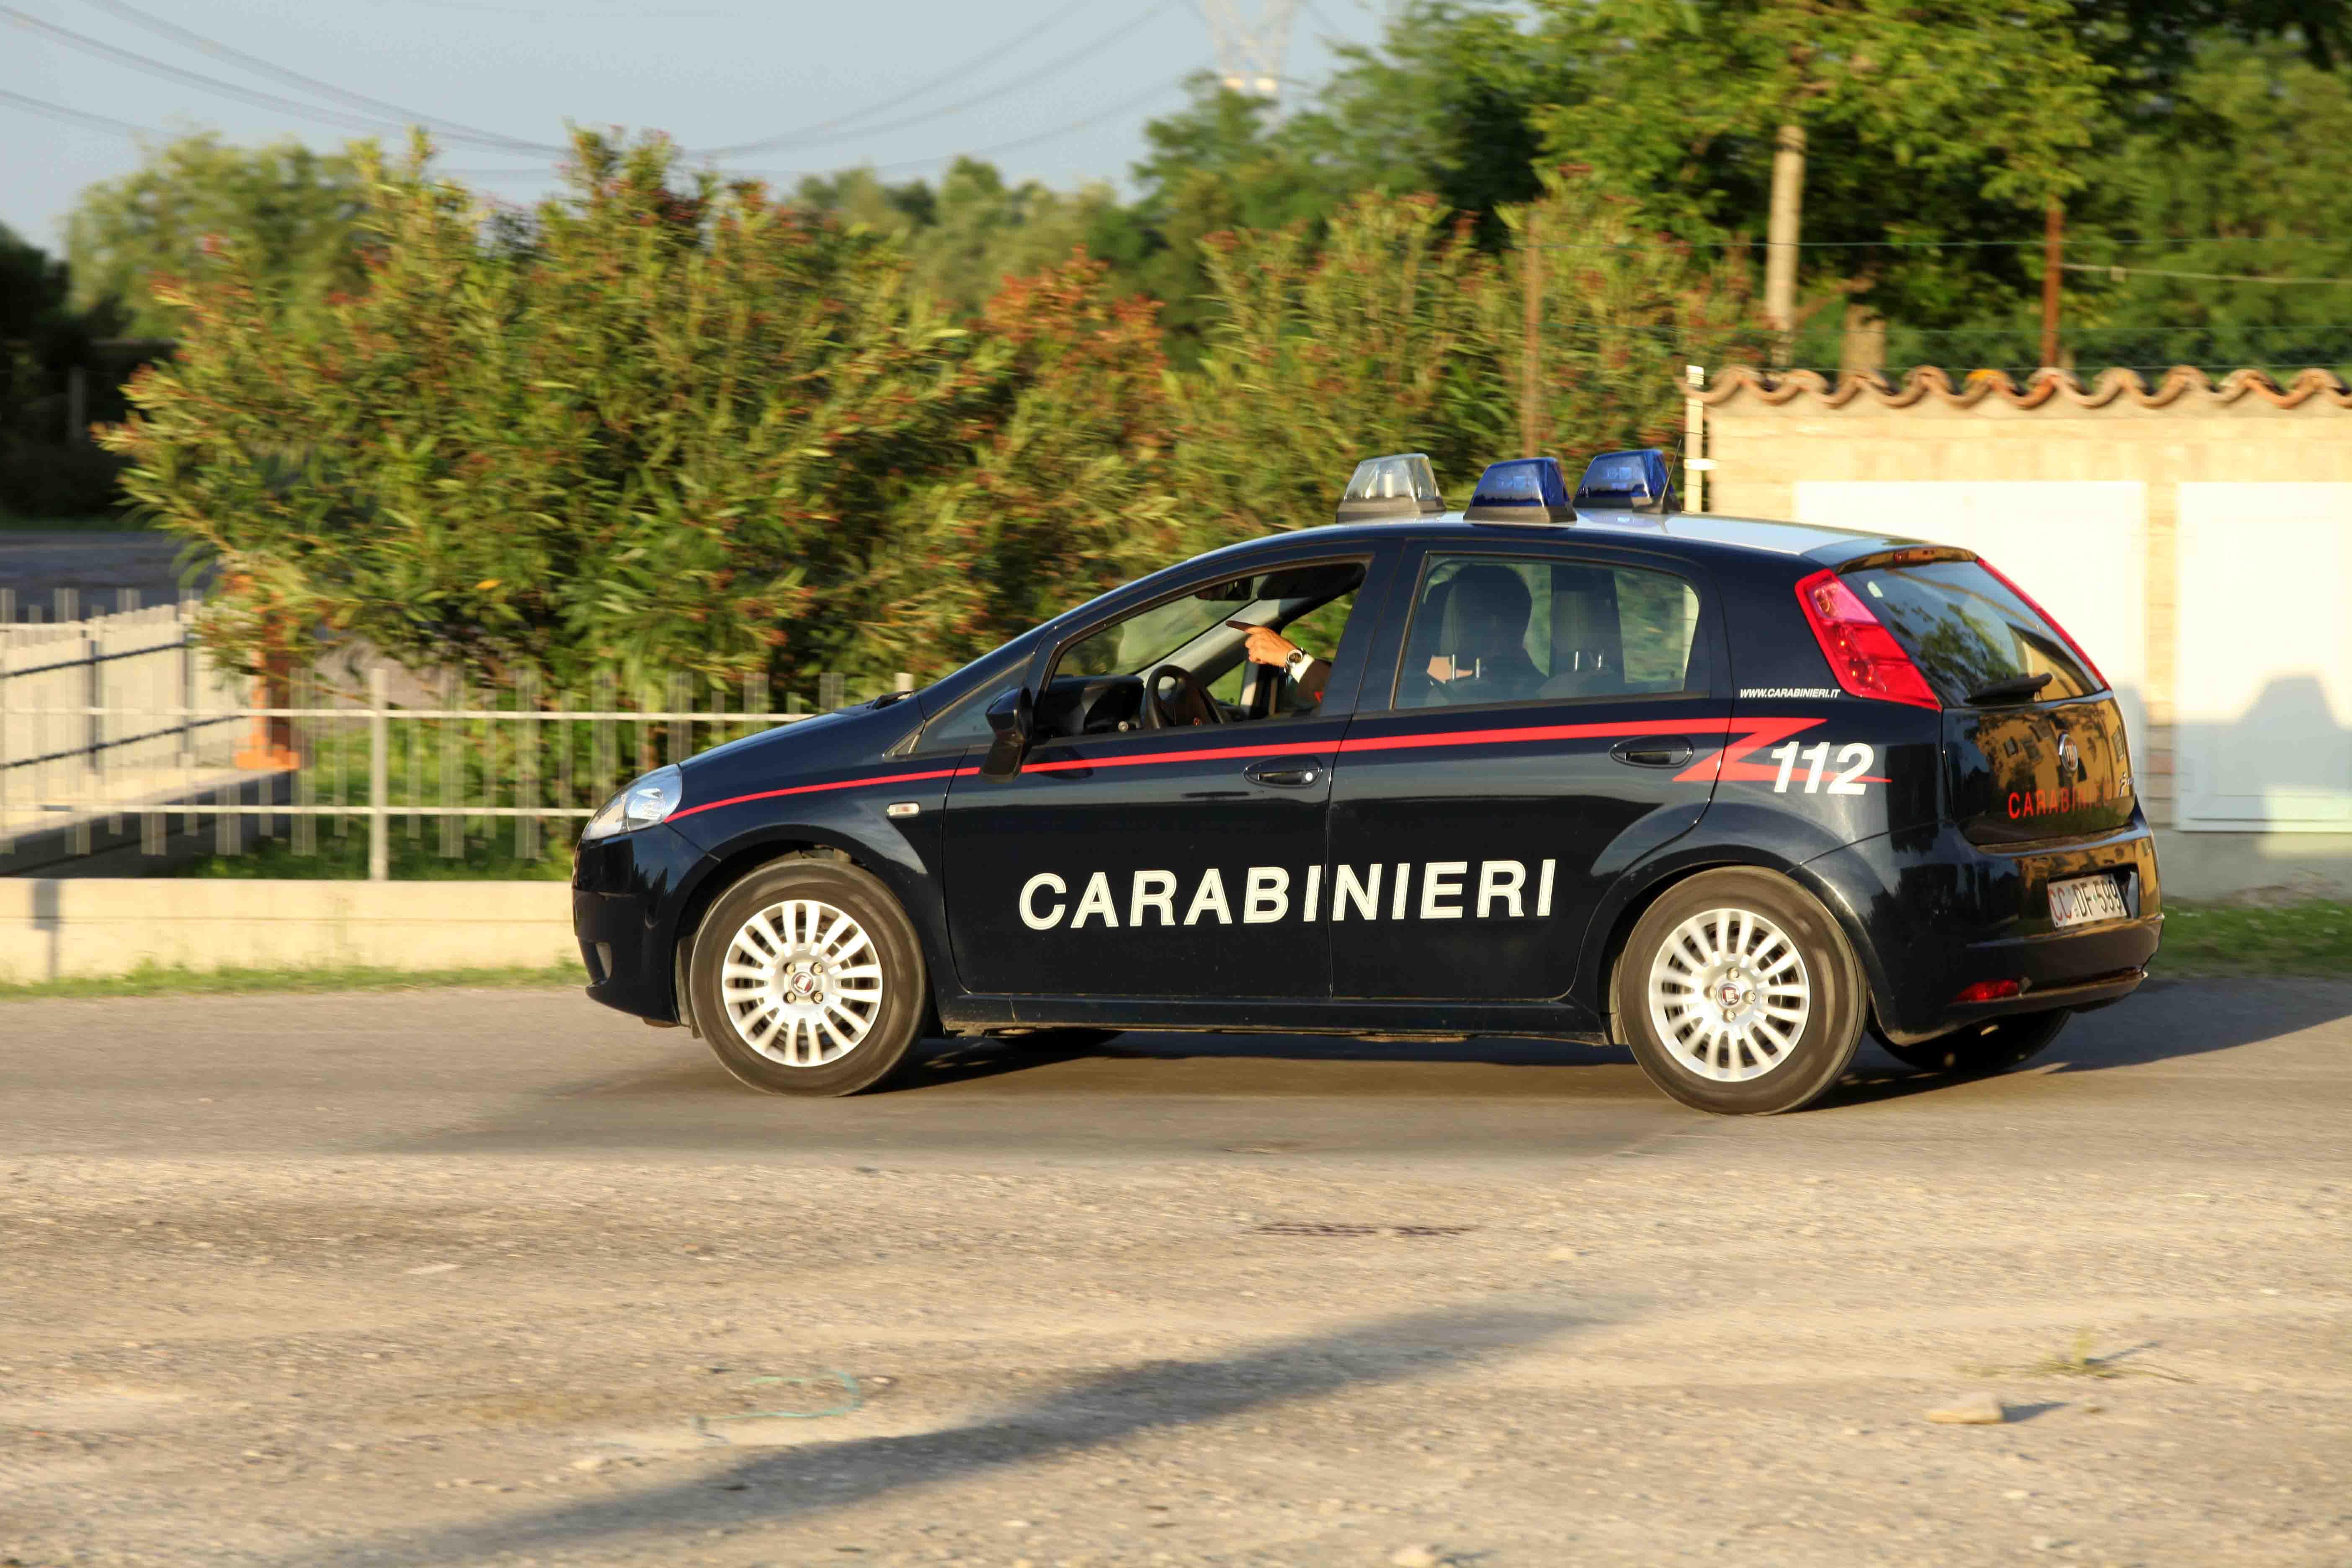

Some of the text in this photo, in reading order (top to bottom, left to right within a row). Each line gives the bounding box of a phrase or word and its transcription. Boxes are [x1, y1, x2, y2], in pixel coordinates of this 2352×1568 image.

[1740, 688, 1841, 699] WWW.CARABINIERI.IT
[1771, 741, 1874, 795] 112
[1019, 859, 1556, 930] CARABINIERI
